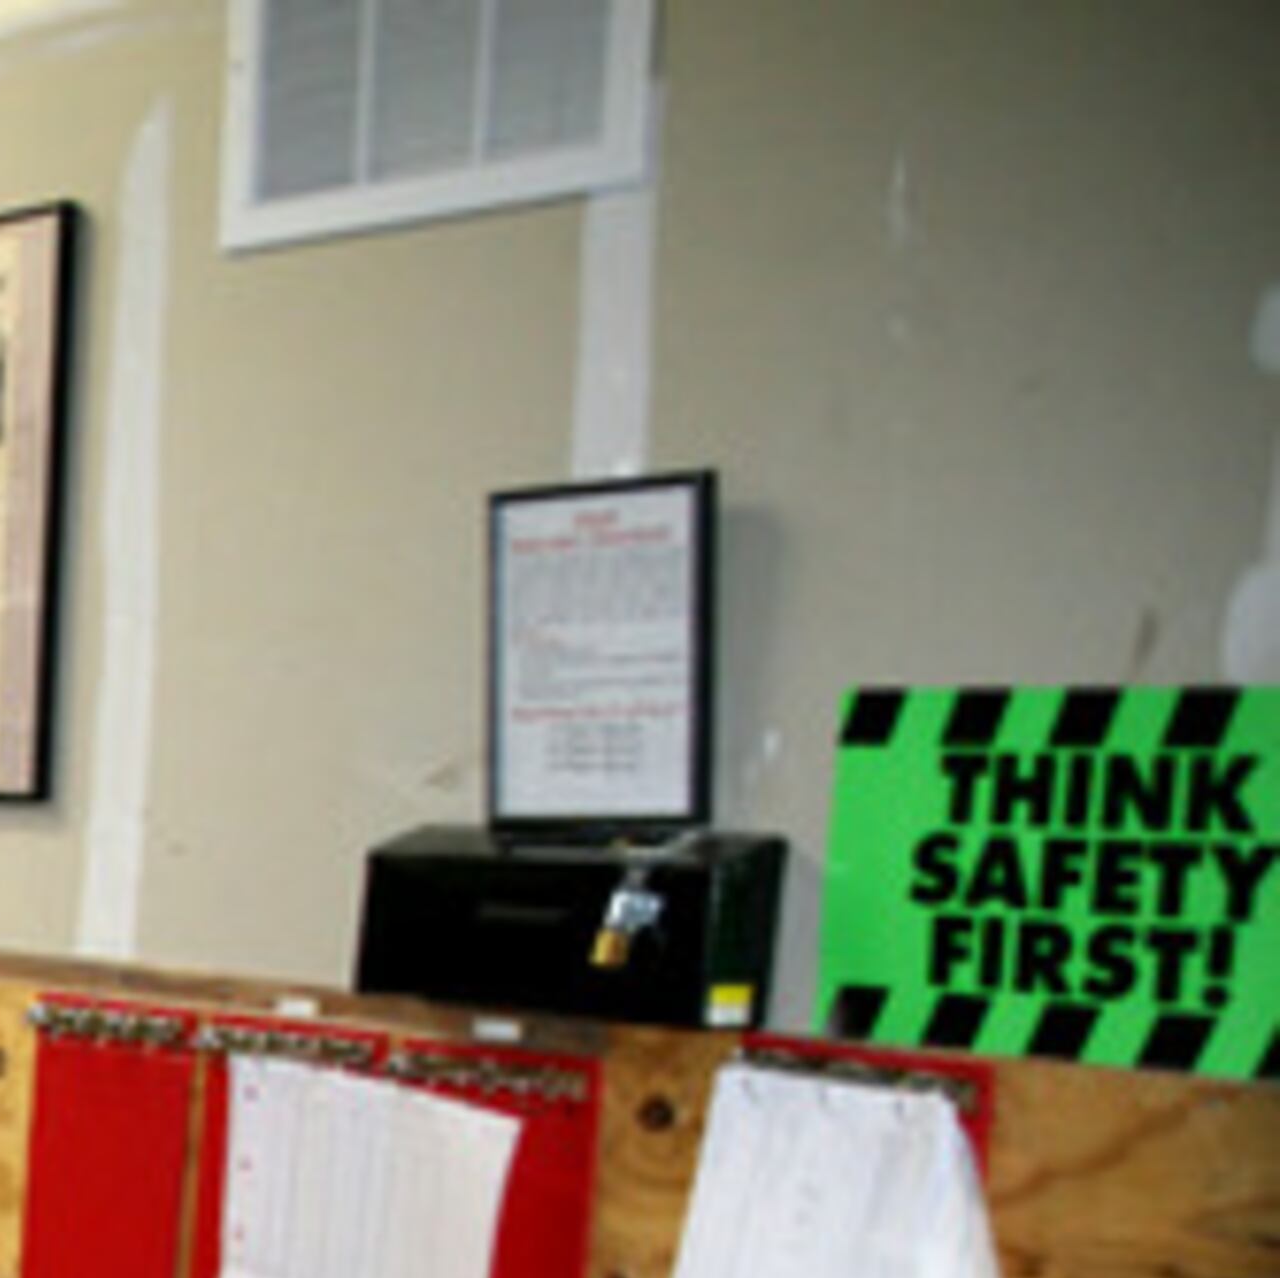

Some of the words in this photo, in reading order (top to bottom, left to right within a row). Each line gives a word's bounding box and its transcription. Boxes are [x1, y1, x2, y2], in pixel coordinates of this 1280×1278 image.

[941, 753, 1260, 833] THINK
[909, 831, 1280, 923] SAFETY
[927, 914, 1237, 1009] FIRST!
